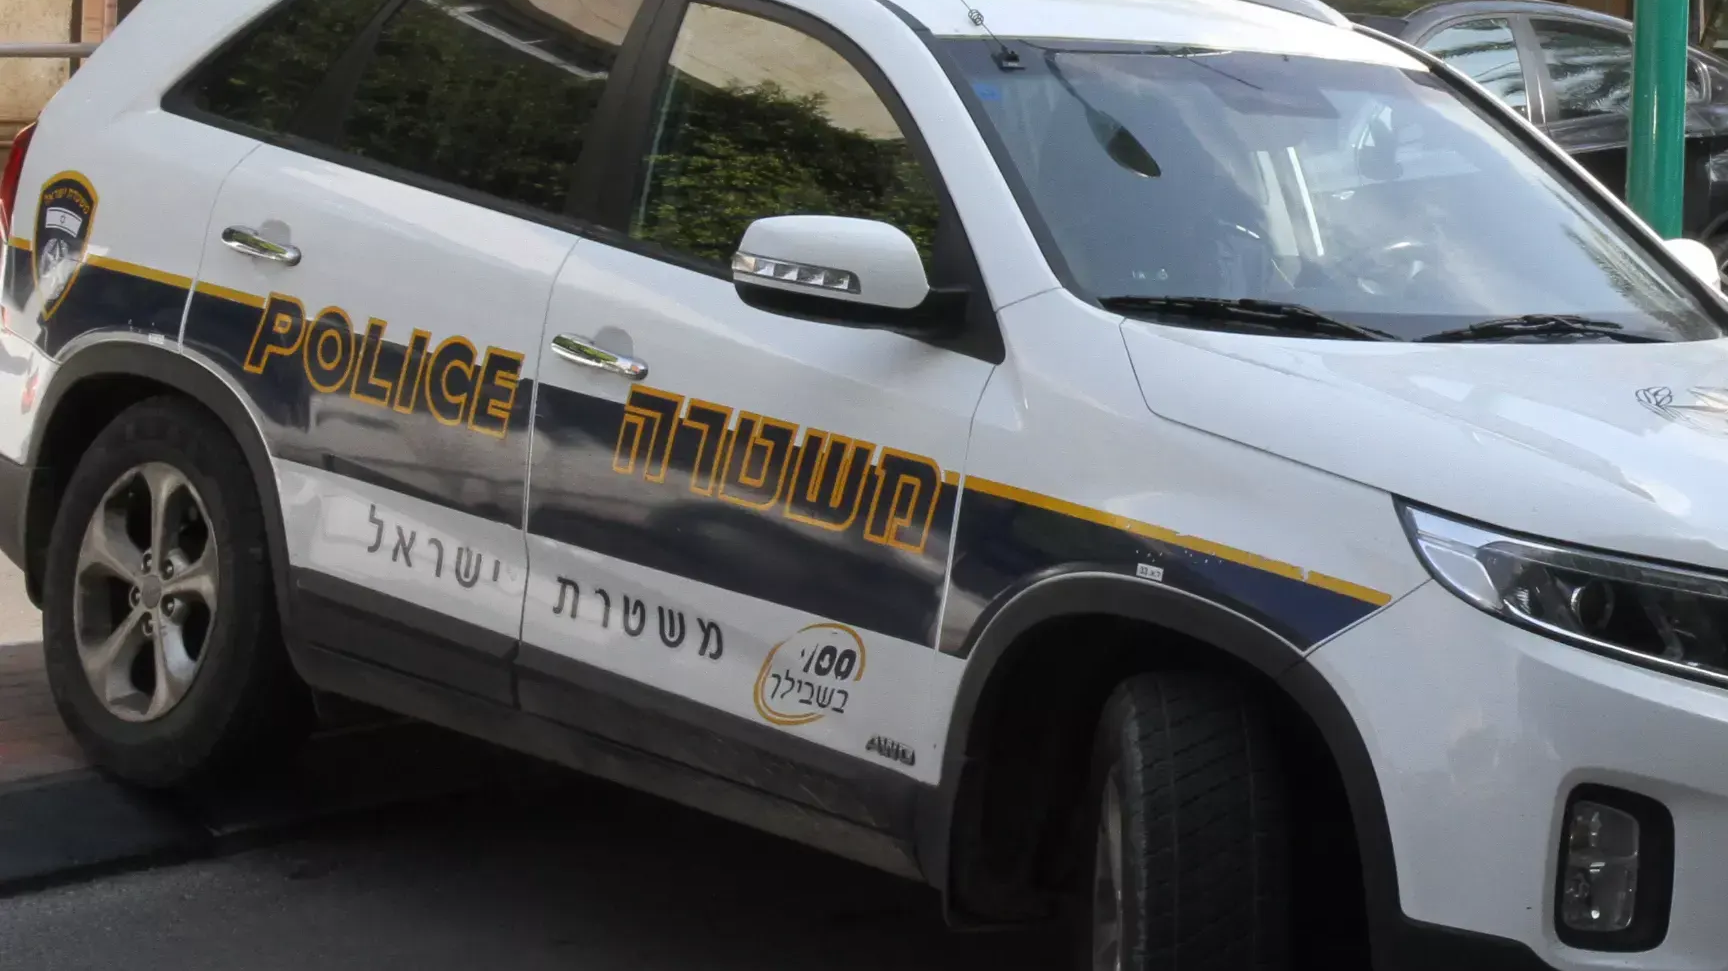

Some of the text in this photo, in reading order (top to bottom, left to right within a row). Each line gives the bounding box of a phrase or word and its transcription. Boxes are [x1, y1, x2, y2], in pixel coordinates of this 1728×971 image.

[244, 291, 526, 438] POLICE
[612, 383, 944, 553] משטרה
[366, 504, 727, 662] משטרת ישראל
[770, 668, 850, 714] בשבילך
